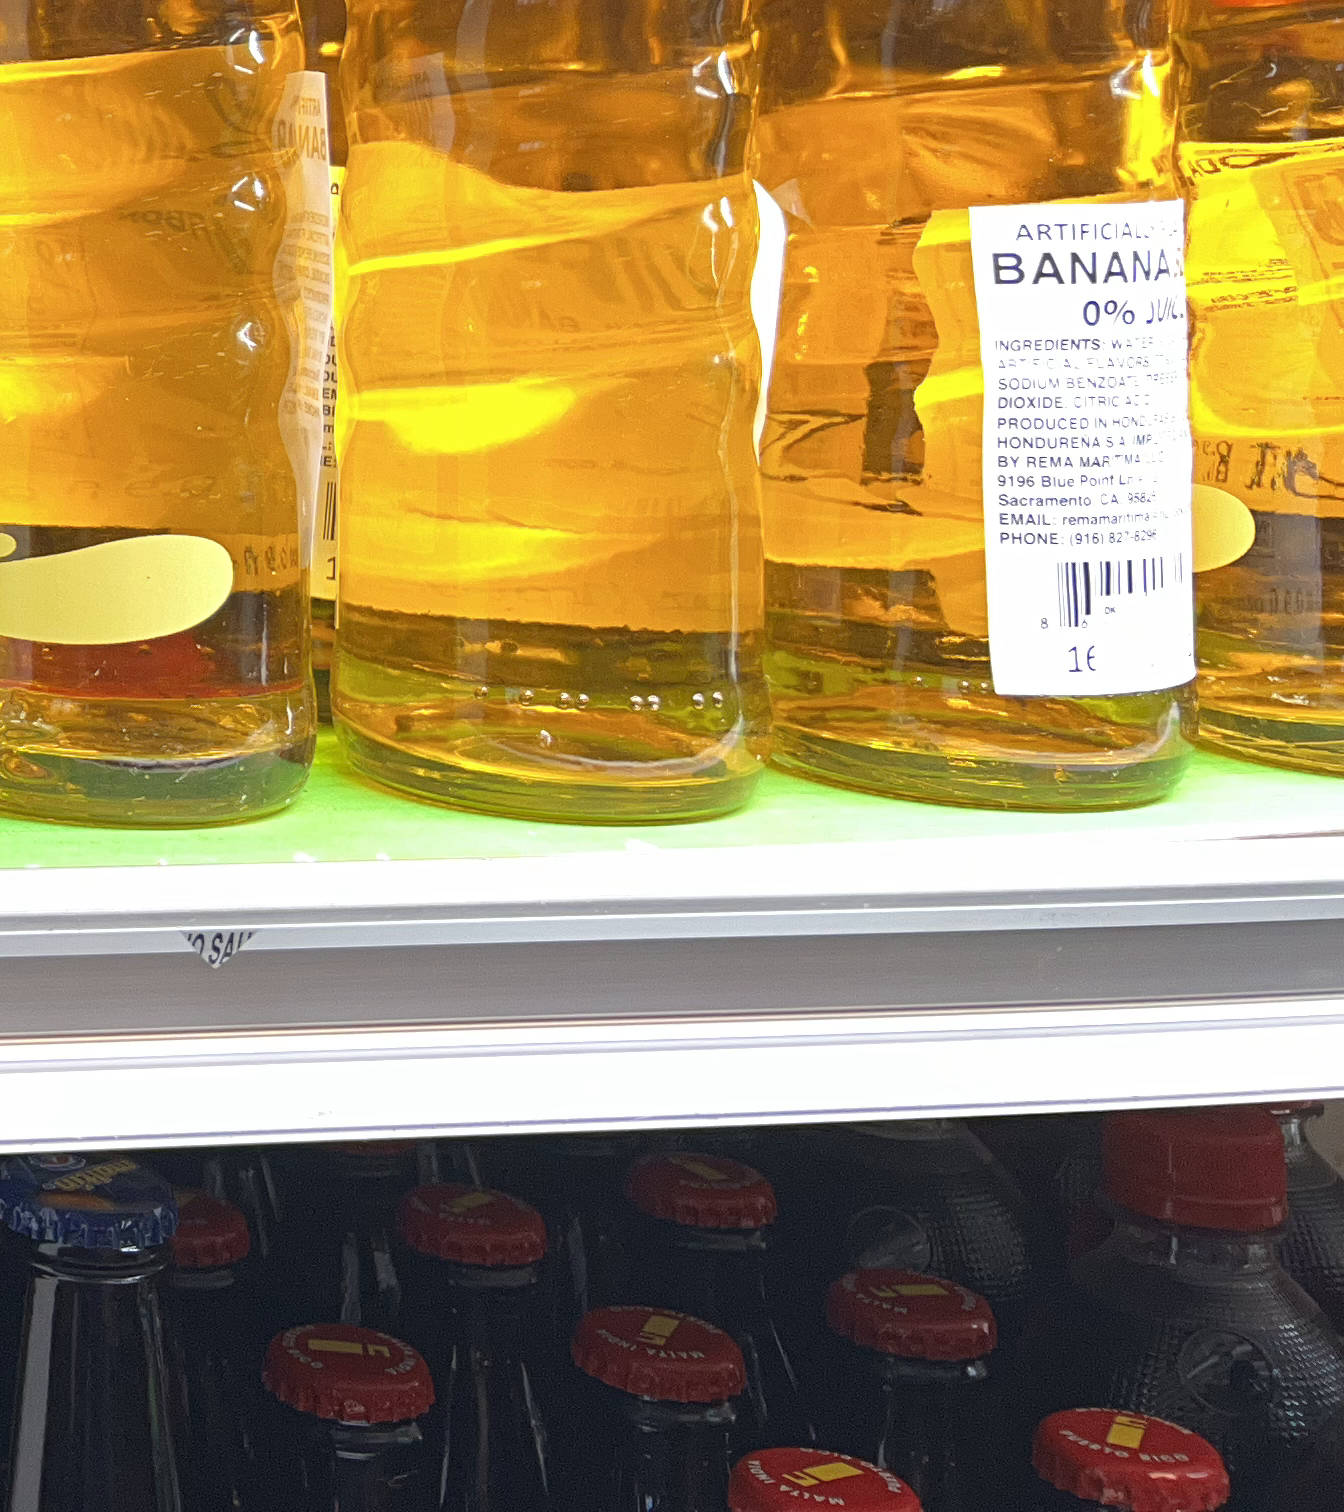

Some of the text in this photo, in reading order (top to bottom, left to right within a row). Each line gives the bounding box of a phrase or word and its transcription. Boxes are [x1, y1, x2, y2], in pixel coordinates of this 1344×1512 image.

[992, 249, 1171, 285] BANANA
[1082, 299, 1136, 327] 0%
[998, 377, 1061, 391] SODIUM
[997, 417, 1090, 430] PRODUCED
[1094, 417, 1108, 429] IN
[997, 455, 1020, 468] BY
[1026, 456, 1074, 469] REMA
[997, 475, 1035, 488] 9196
[1041, 475, 1075, 489] Blue
[1080, 474, 1114, 488] Point
[999, 512, 1057, 526] EMAIL:
[999, 531, 1065, 545] PHONE:
[1069, 531, 1105, 546] (916)
